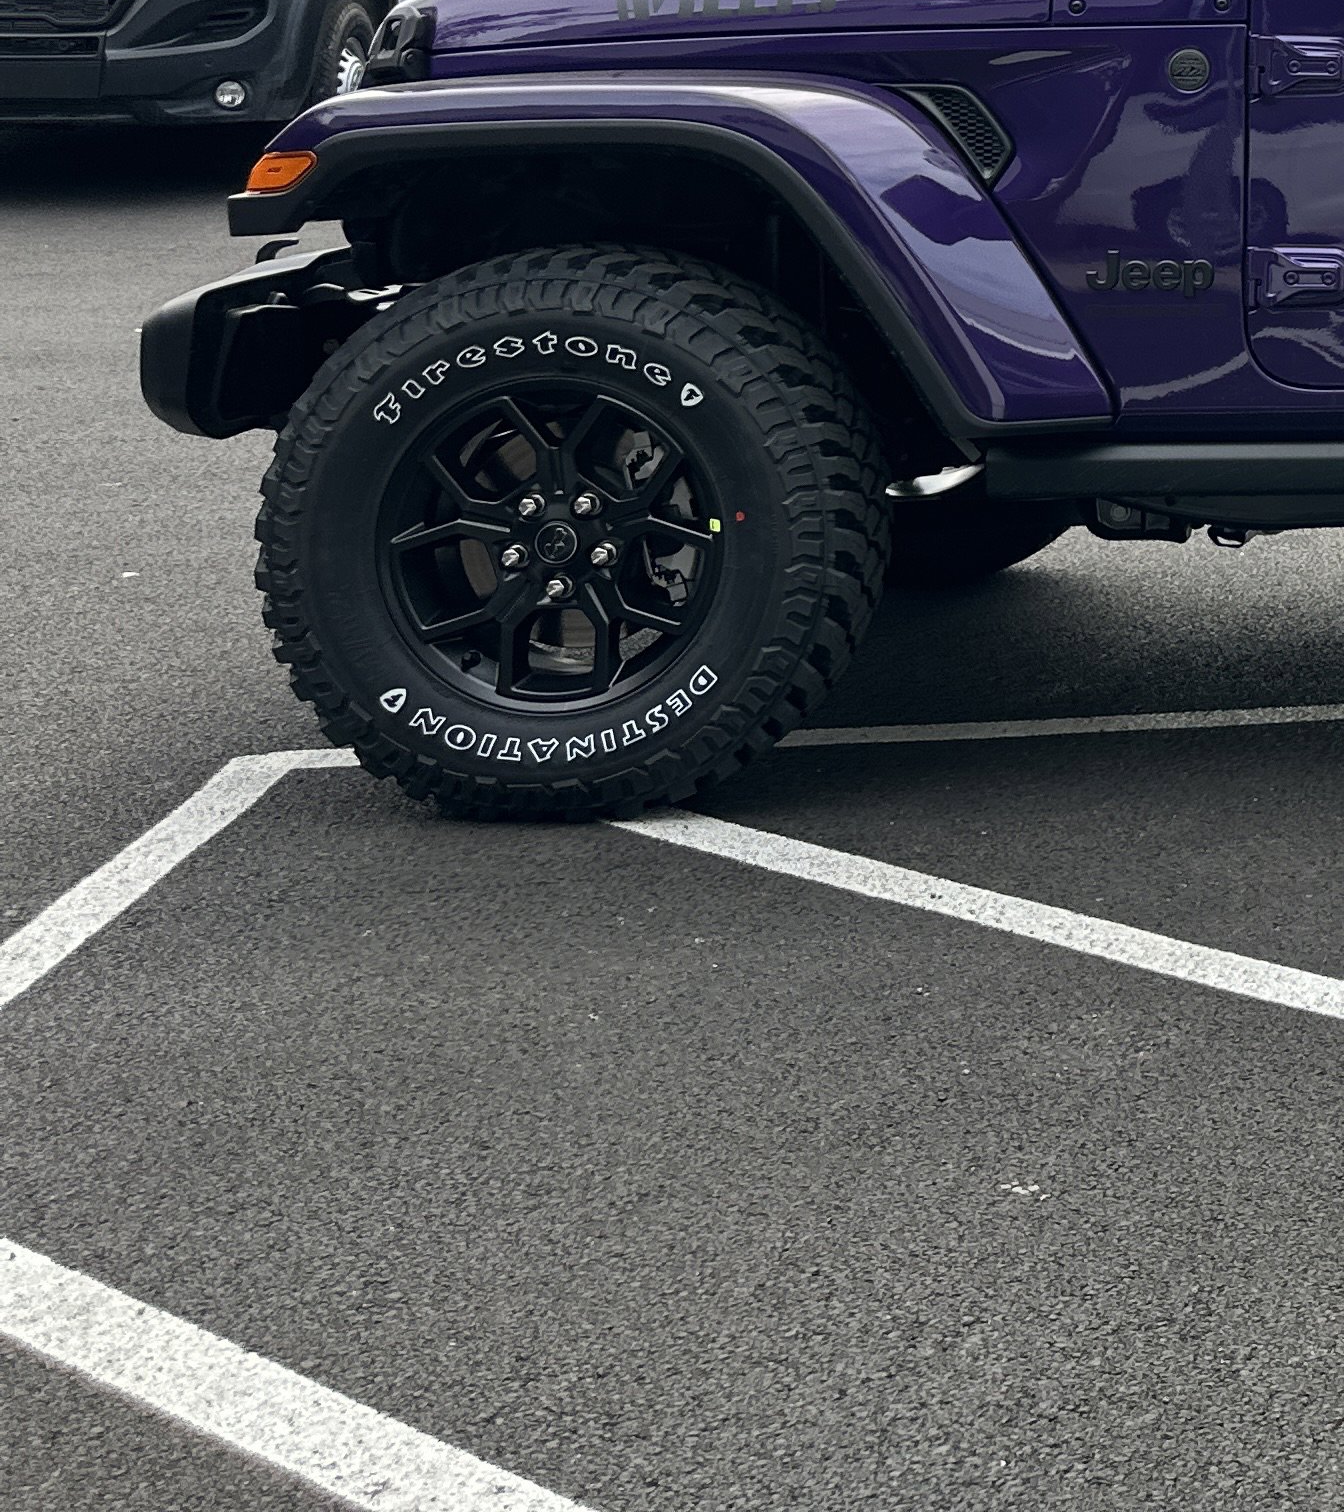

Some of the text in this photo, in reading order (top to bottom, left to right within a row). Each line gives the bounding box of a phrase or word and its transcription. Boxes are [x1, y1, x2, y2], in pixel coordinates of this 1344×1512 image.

[1085, 249, 1215, 297] Jeep
[373, 331, 672, 424] Firestone
[408, 664, 718, 763] DESTINATION
